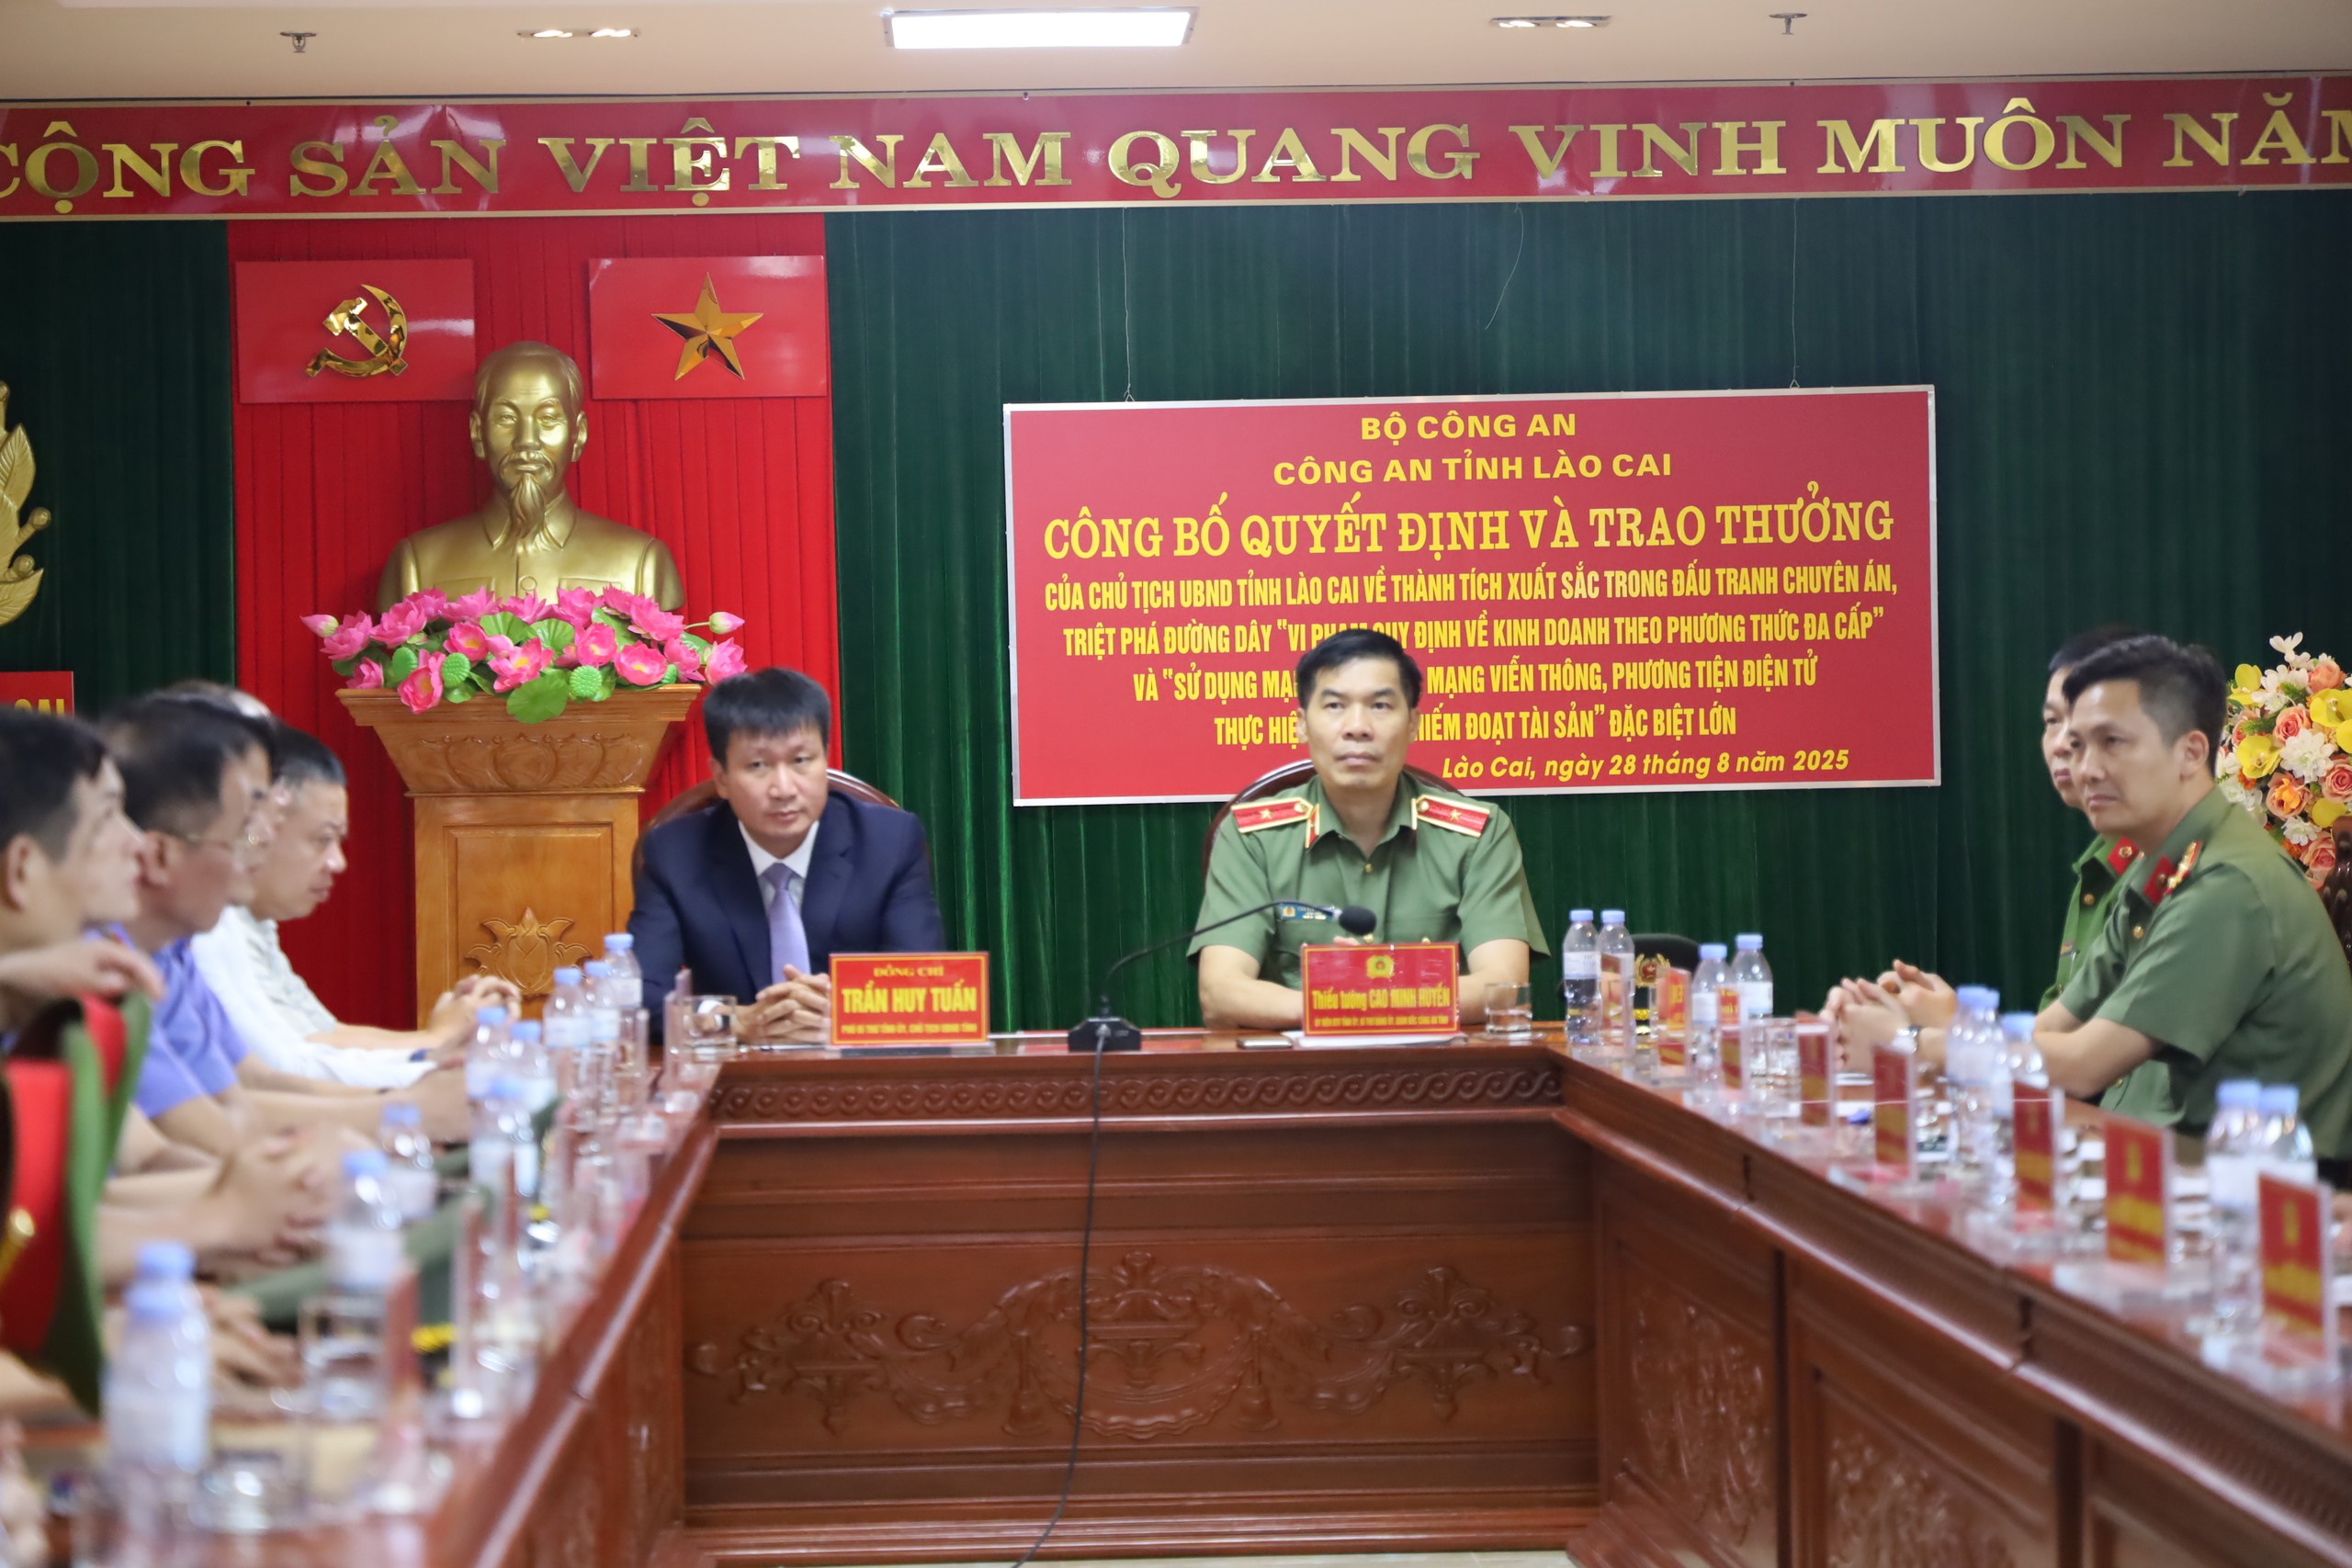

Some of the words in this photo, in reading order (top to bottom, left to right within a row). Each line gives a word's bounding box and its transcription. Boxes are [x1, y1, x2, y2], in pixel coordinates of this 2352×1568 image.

[0, 120, 255, 214] ỘNG
[289, 115, 507, 196] SẢN
[537, 117, 800, 207] VIỆT
[829, 131, 1071, 189] NAM
[1108, 123, 1480, 198] QUANG
[1509, 120, 1786, 179] VINH
[1816, 97, 2132, 172] MUÔN
[1362, 412, 1408, 446] BỘ
[1417, 410, 1517, 440] CÔNG
[1526, 413, 1577, 436] AN
[1273, 456, 1374, 485] CÔNG
[1383, 459, 1432, 482] AN
[1441, 448, 1523, 480] TỈNH
[1533, 449, 1602, 479] LÀO
[1612, 454, 1671, 477] CAI
[1044, 505, 1164, 559] CÔNG
[1172, 491, 1231, 557] BỐ
[1239, 491, 1387, 558] QUYẾT
[1396, 511, 1510, 561] ĐỊNH
[1519, 495, 1579, 549] VÀ
[1589, 505, 1706, 547] TRAO
[1714, 480, 1894, 545] THƯỞNG
[1045, 573, 1085, 612] CỦA
[1088, 572, 1128, 610] CHỦ
[1131, 581, 1176, 615] TỊCH
[1180, 579, 1233, 608] UBND
[1237, 569, 1283, 607] TỈNH
[1285, 571, 1323, 605] LÀO
[1327, 576, 1360, 605] CAI
[1363, 565, 1387, 604] VỀ
[1391, 569, 1456, 603] THÀNH
[1459, 567, 1503, 601] TÍCH
[1508, 561, 1557, 600] XUẤT
[1561, 560, 1600, 600] SẮC
[1604, 570, 1668, 599] TRONG
[1671, 558, 1712, 597] ĐẤU
[1715, 567, 1779, 596] TRANH
[1782, 560, 1860, 594] CHUYÊN
[1863, 558, 1898, 595] ÁN,
[1063, 621, 1117, 661] TRIỆT
[1120, 620, 1160, 655] PHÁ
[1163, 617, 1231, 655] ĐƯỜNG
[1235, 618, 1273, 653] DÂY
[1413, 620, 1462, 654] ĐỊNH
[1464, 609, 1489, 648] VỀ
[1493, 618, 1541, 647] KINH
[1544, 616, 1611, 646] DOANH
[1614, 616, 1663, 645] THEO
[1667, 613, 1747, 644] PHƯƠNG
[1750, 608, 1800, 642] THỨC
[1804, 612, 1831, 641] ĐA
[1133, 667, 1159, 702] VÀ
[1204, 670, 1259, 705] DỤNG
[1426, 665, 1486, 700] MẠNG
[1489, 655, 1534, 694] VIỄN
[1538, 657, 1608, 694] THÔNG,
[1611, 659, 1691, 691] PHƯƠNG
[1695, 654, 1739, 694] TIỆN
[1742, 653, 1790, 693] ĐIỆN
[1792, 648, 1819, 686] TỬ
[1214, 714, 1264, 751] THỰC
[1268, 711, 1300, 750] HIỆ
[1464, 711, 1516, 745] ĐOẠT
[1519, 705, 1550, 739] TÀI
[1609, 705, 1649, 743] ĐẶC
[1652, 703, 1695, 741] BIỆT
[1698, 701, 1737, 737] LỚN
[1442, 756, 1485, 779] Lào
[1489, 756, 1537, 780] Cai,
[1544, 753, 1605, 781] ngày
[1608, 754, 1637, 775] 28
[1642, 750, 1711, 780] tháng
[1716, 751, 1731, 774] 8
[1736, 750, 1786, 773] năm
[1792, 749, 1850, 772] 2025
[891, 987, 927, 1012] HUY
